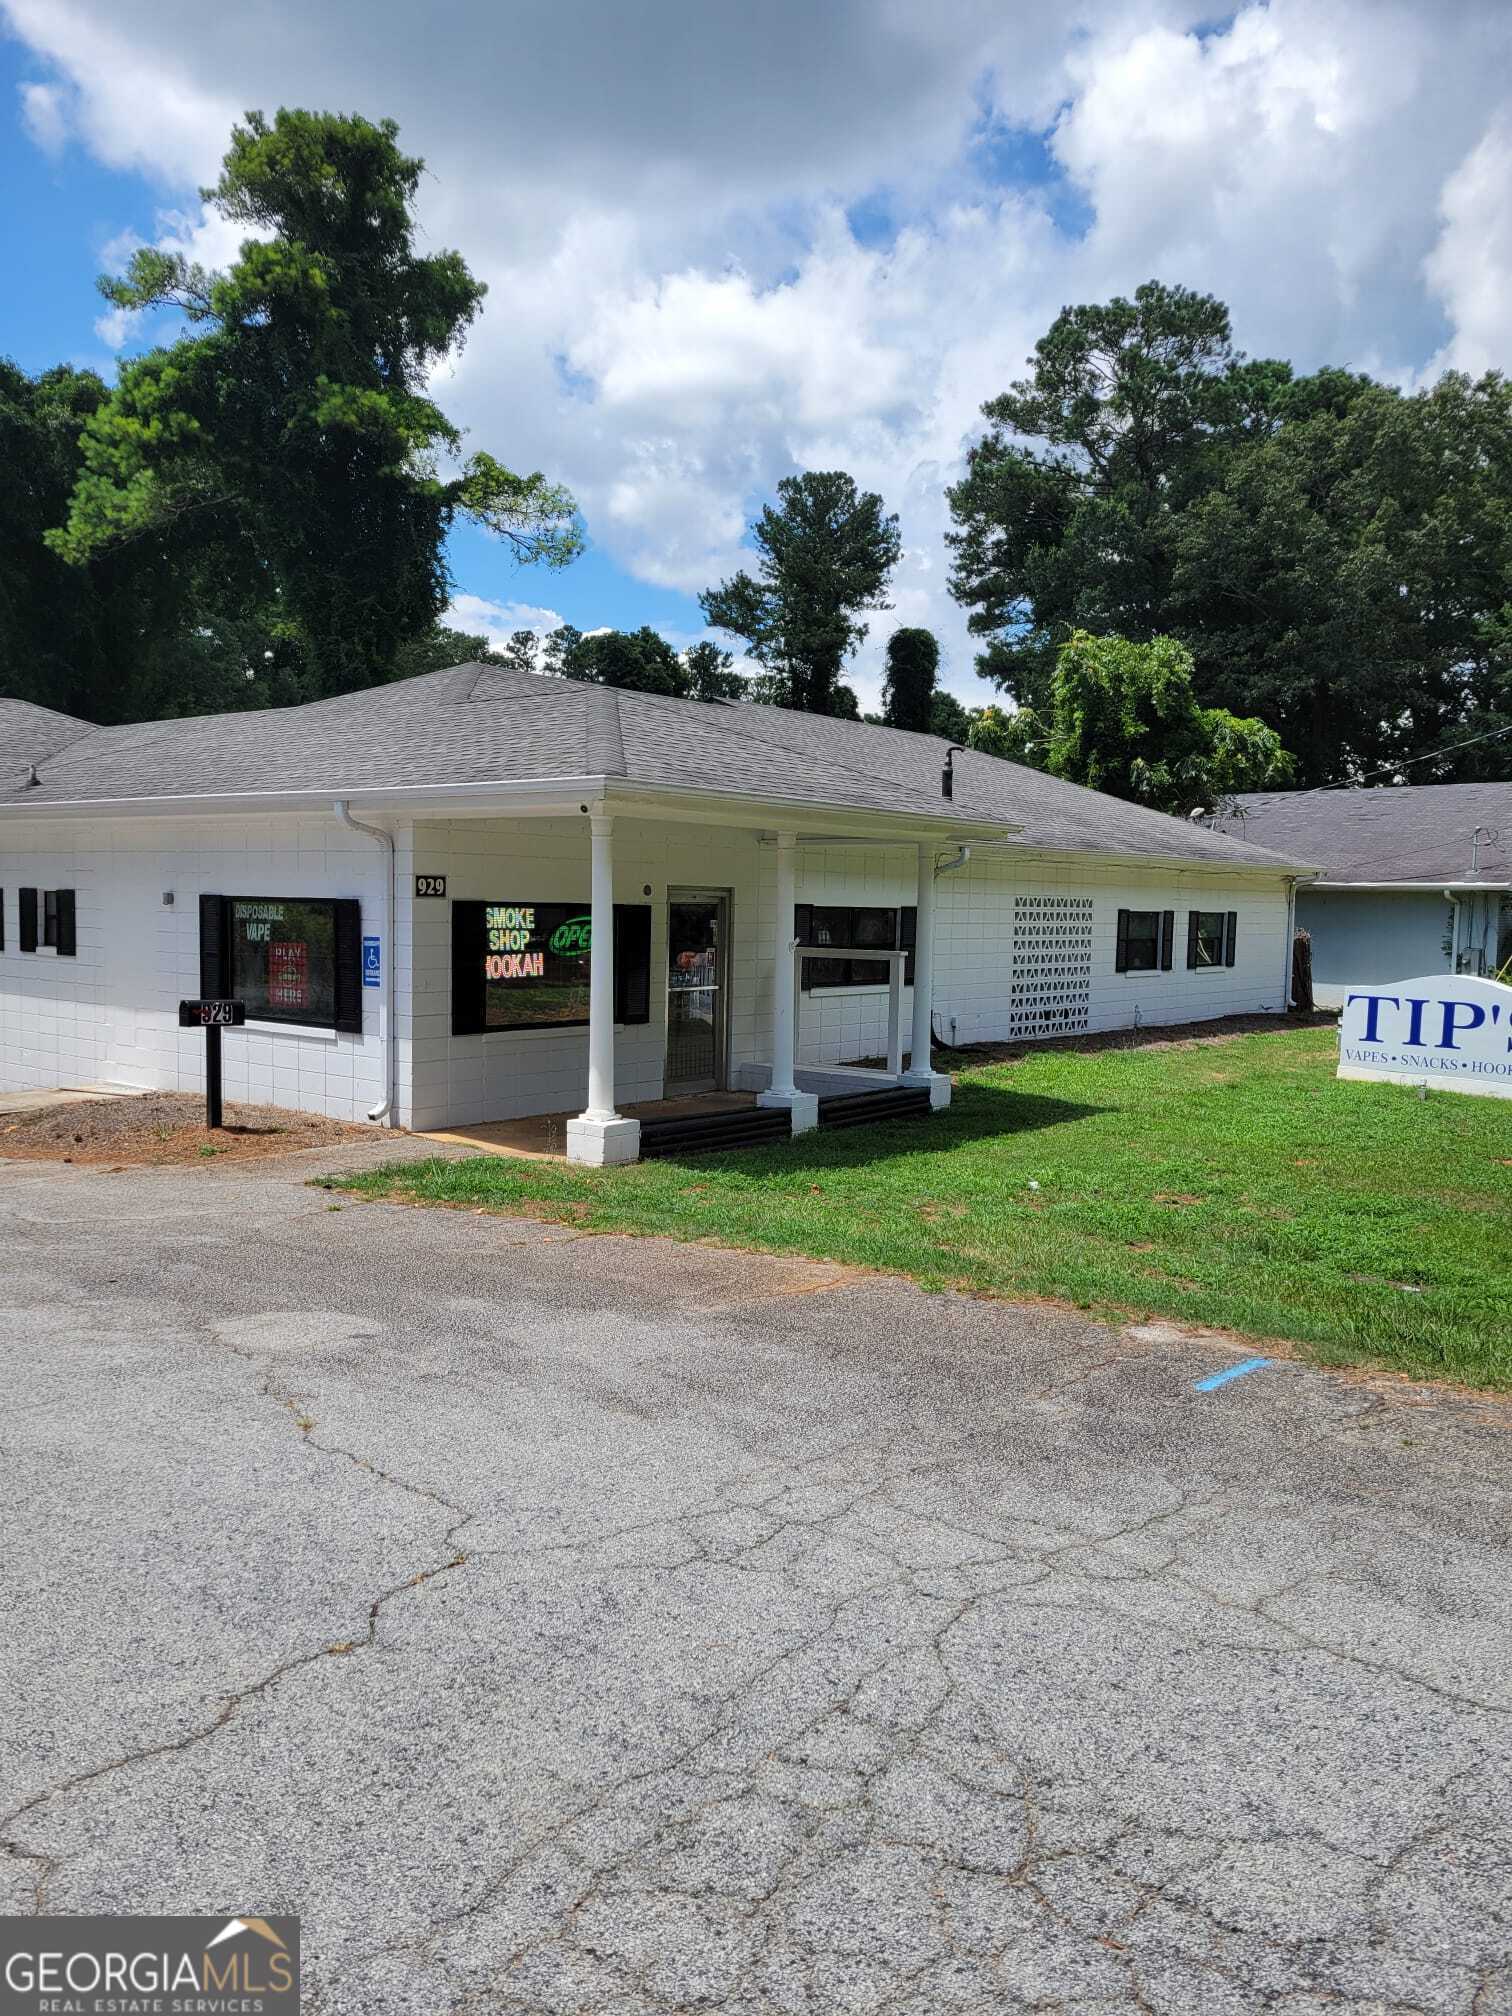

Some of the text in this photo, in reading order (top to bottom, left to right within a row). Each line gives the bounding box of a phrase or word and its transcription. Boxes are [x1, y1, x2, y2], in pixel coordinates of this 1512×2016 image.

[417, 878, 444, 895] 929
[235, 904, 284, 920] DISPOSABLE
[486, 907, 535, 929] SMOKE
[246, 923, 271, 941] VAPE
[489, 929, 530, 951] SHOP
[553, 925, 592, 948] OPE
[275, 947, 301, 961] PLAY
[1347, 995, 1512, 1052] TIP'
[1345, 1049, 1388, 1064] VAPES
[1400, 1055, 1458, 1071] SNACKS
